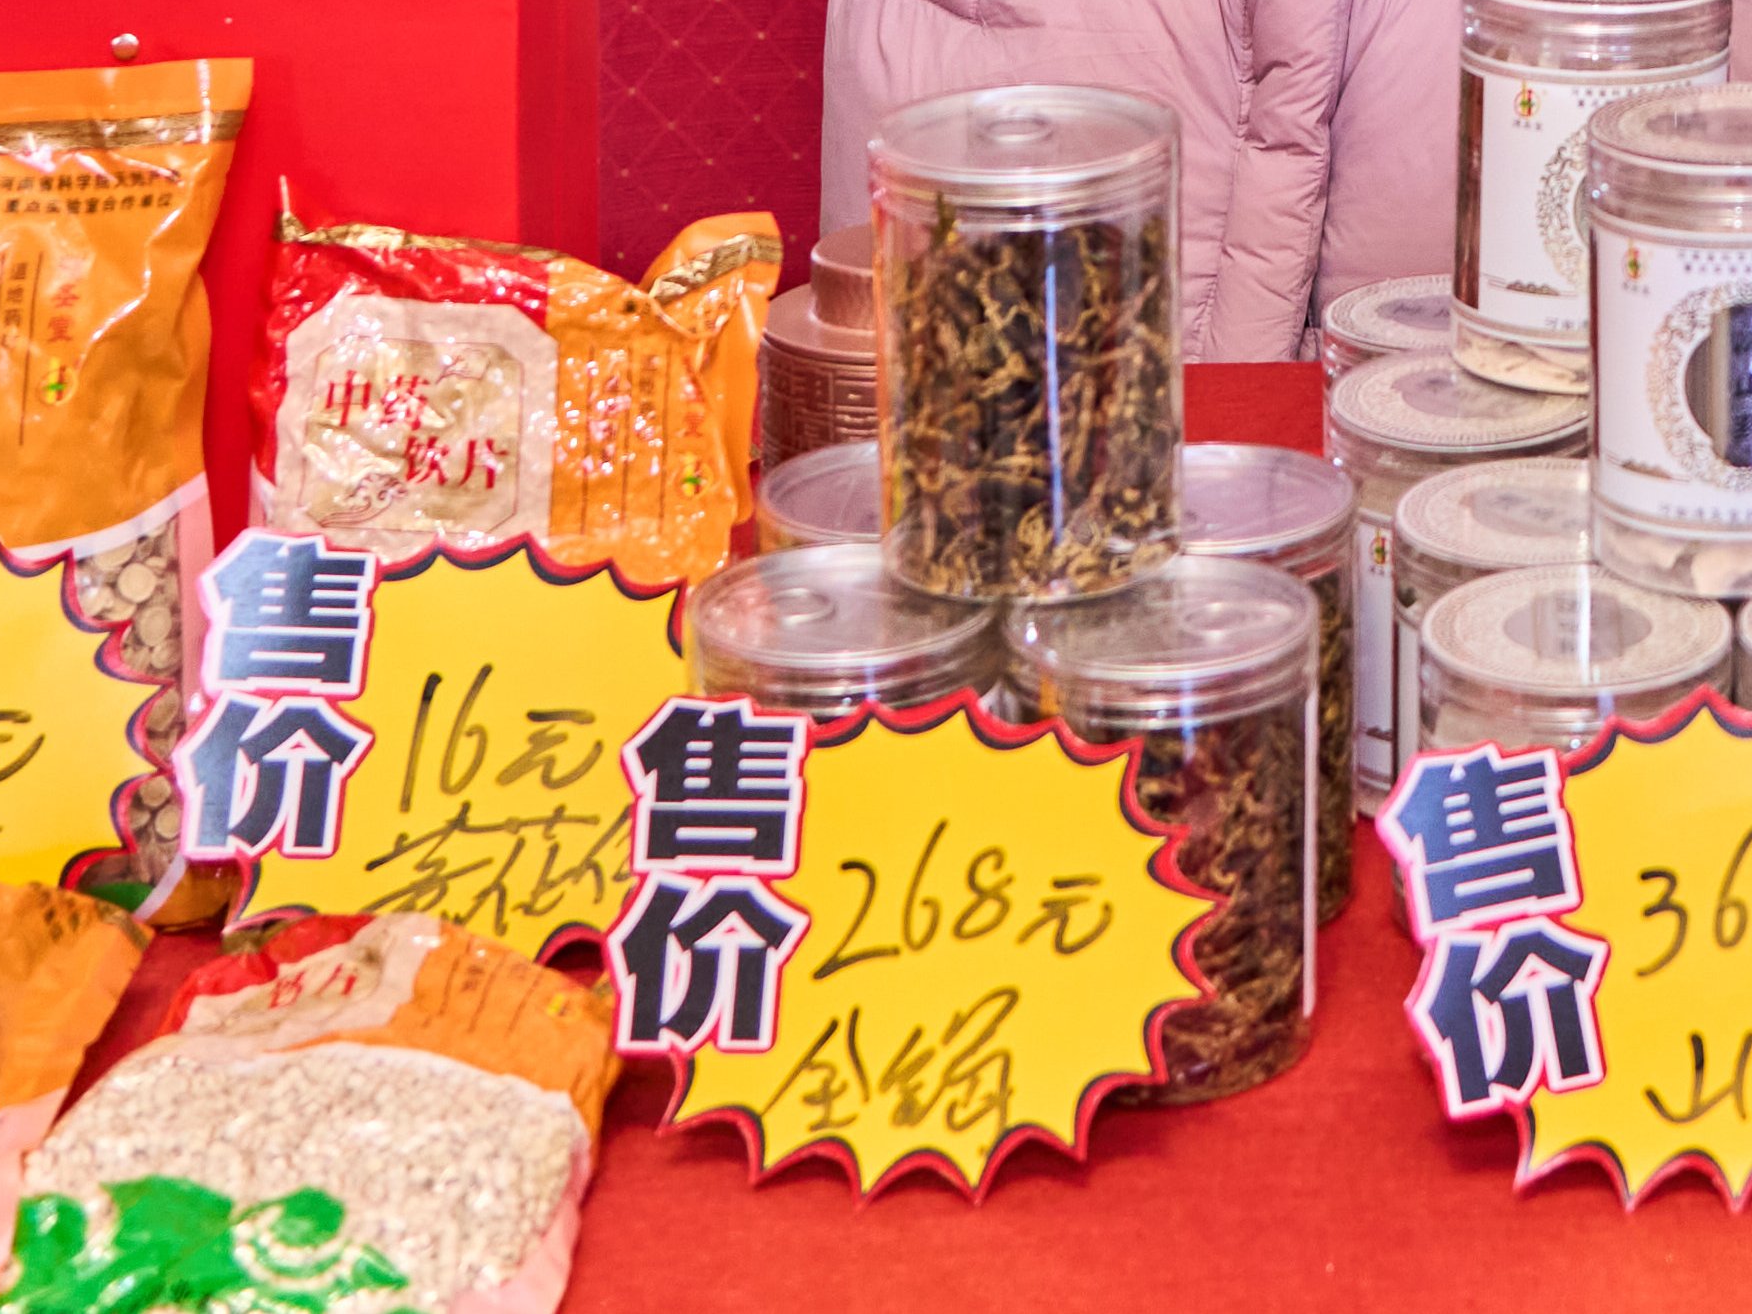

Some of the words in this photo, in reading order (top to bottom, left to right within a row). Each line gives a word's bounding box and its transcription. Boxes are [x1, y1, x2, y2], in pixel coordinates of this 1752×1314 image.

[324, 372, 435, 434] 中药
[402, 435, 511, 492] 饮片
[196, 535, 372, 854] 售价
[399, 661, 605, 813] 16元
[612, 705, 799, 1046] 售价
[812, 818, 1114, 981] 268元
[1386, 752, 1594, 1107] 售价
